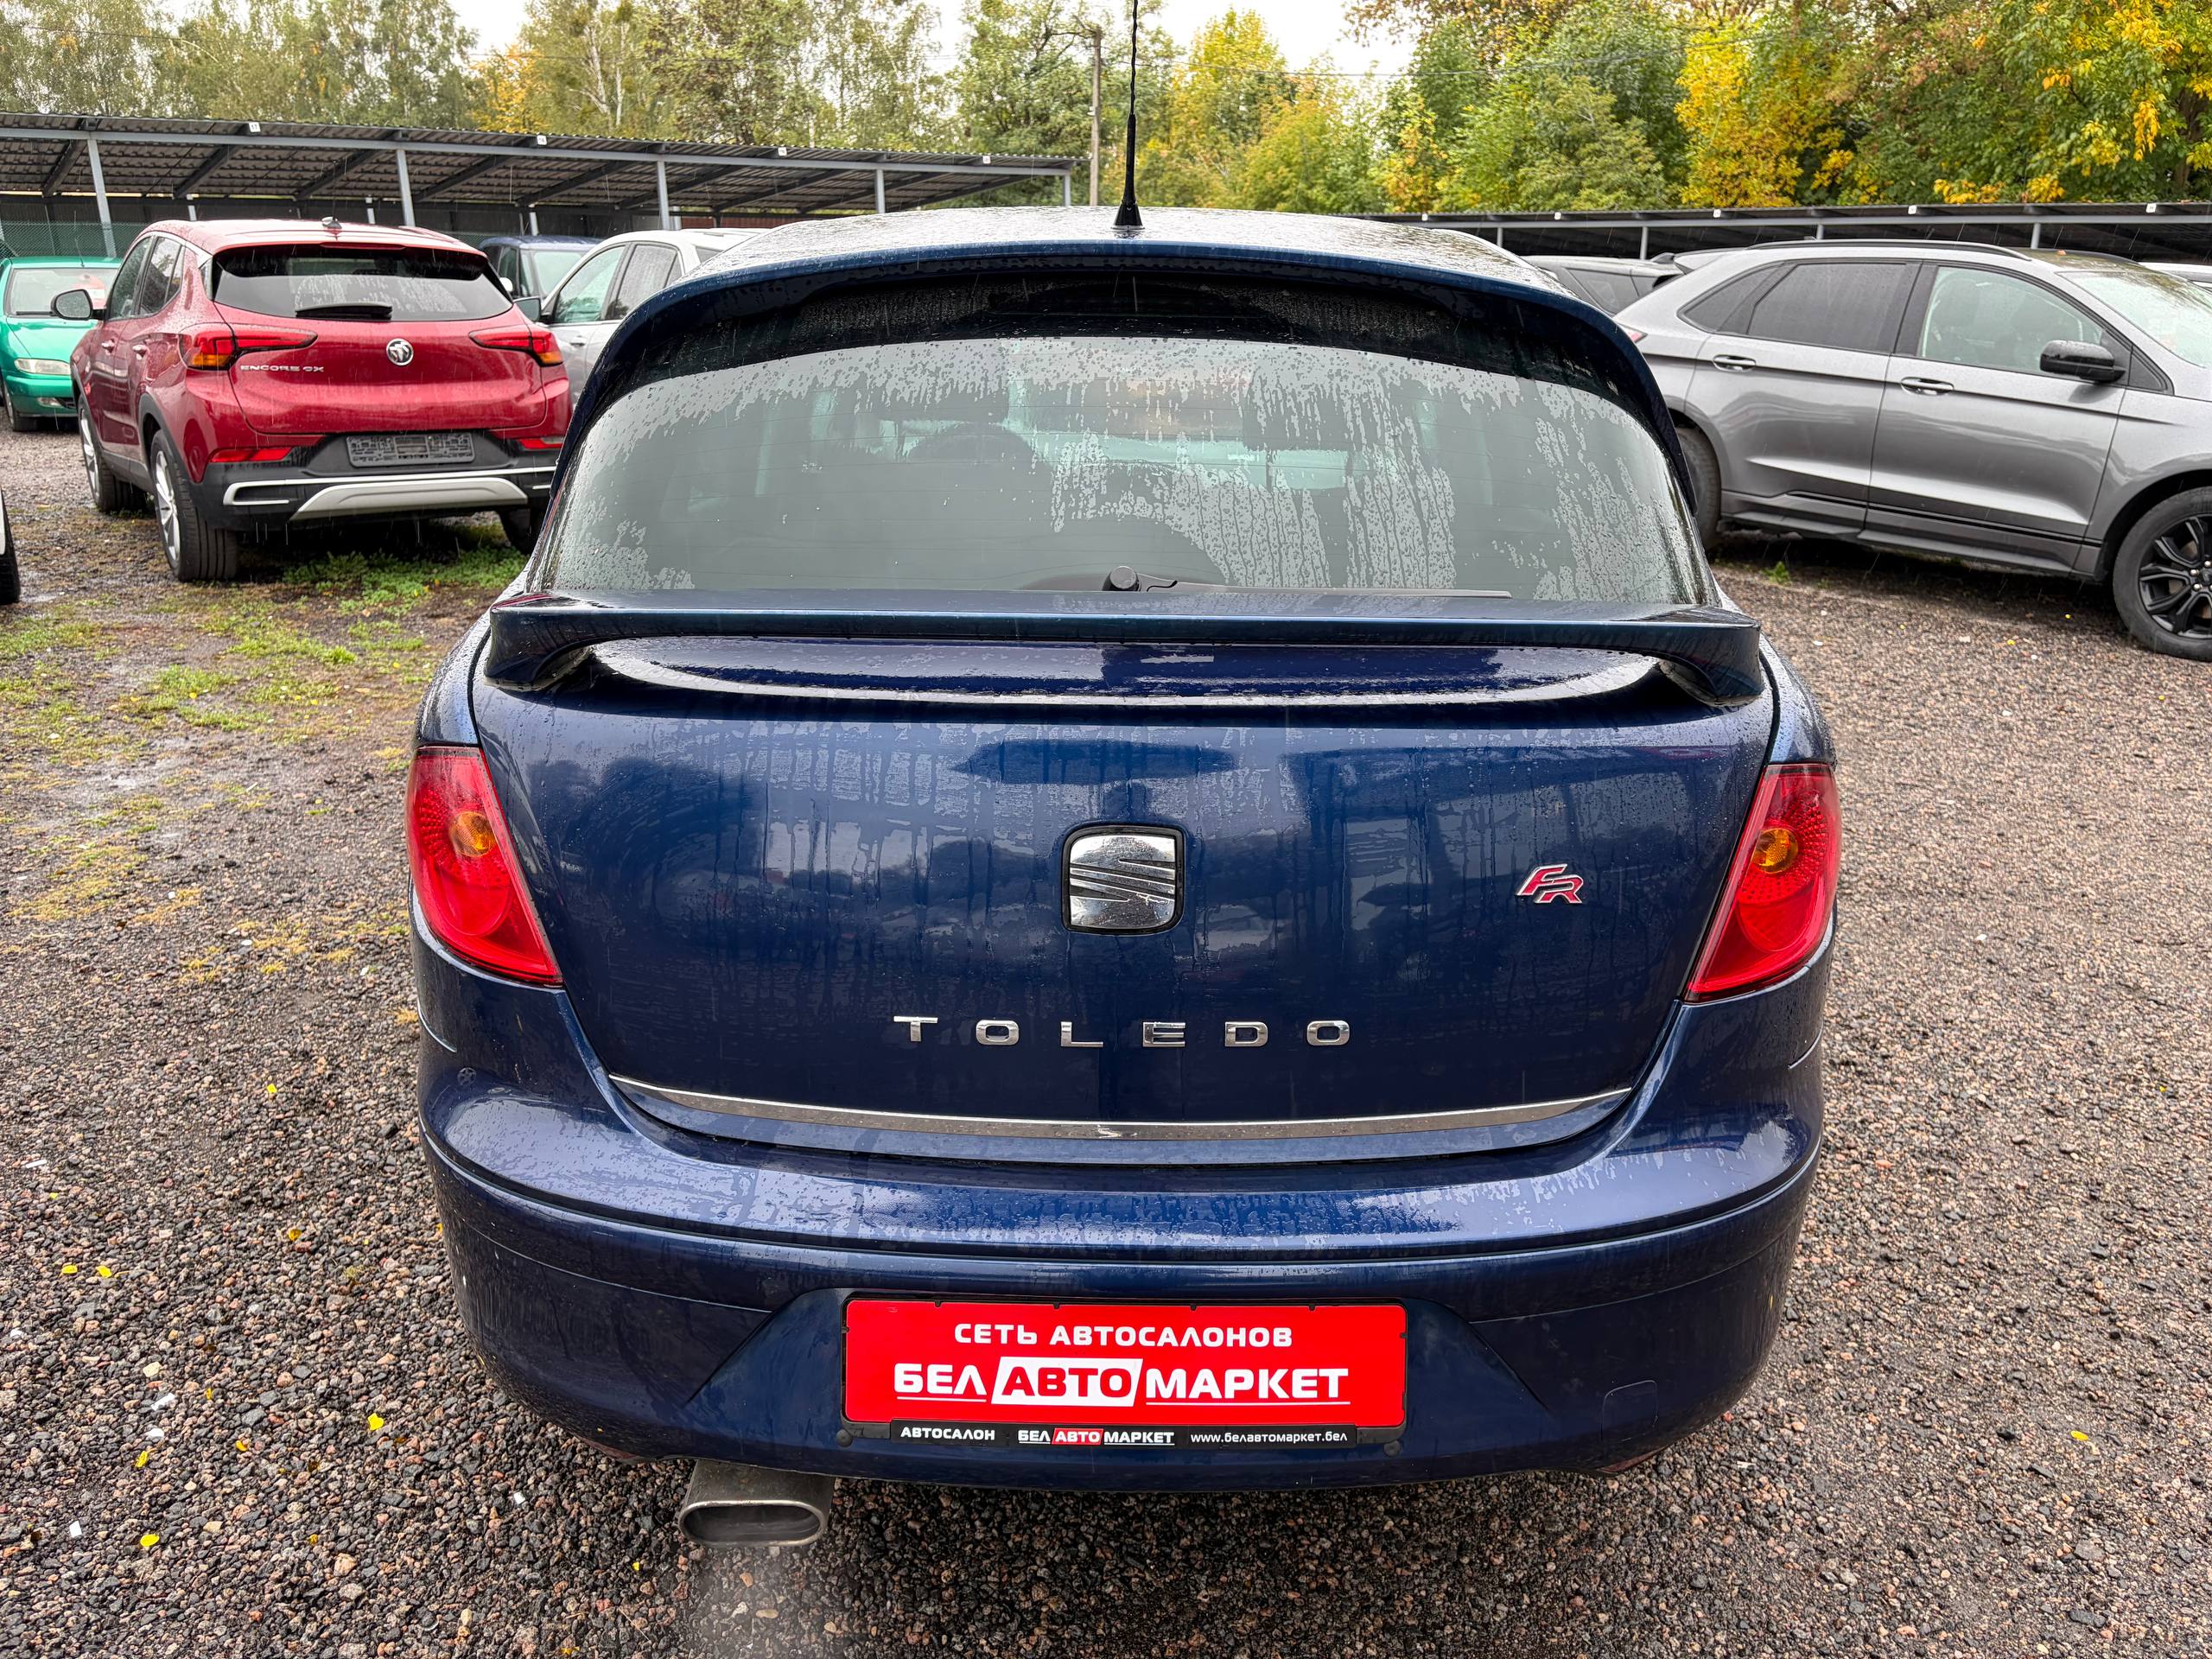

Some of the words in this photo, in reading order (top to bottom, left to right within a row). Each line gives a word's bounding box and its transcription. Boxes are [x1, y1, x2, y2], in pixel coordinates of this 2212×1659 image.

[1516, 863, 1585, 904] FR
[893, 1015, 1351, 1047] TOLEDO
[954, 1323, 1038, 1344] СЕТЬ
[1049, 1325, 1293, 1347] АВТОСАЛОНОВ
[900, 1427, 995, 1440] АВТОСАЛОН
[1190, 1431, 1349, 1444] www.белавтомаркет.бел
